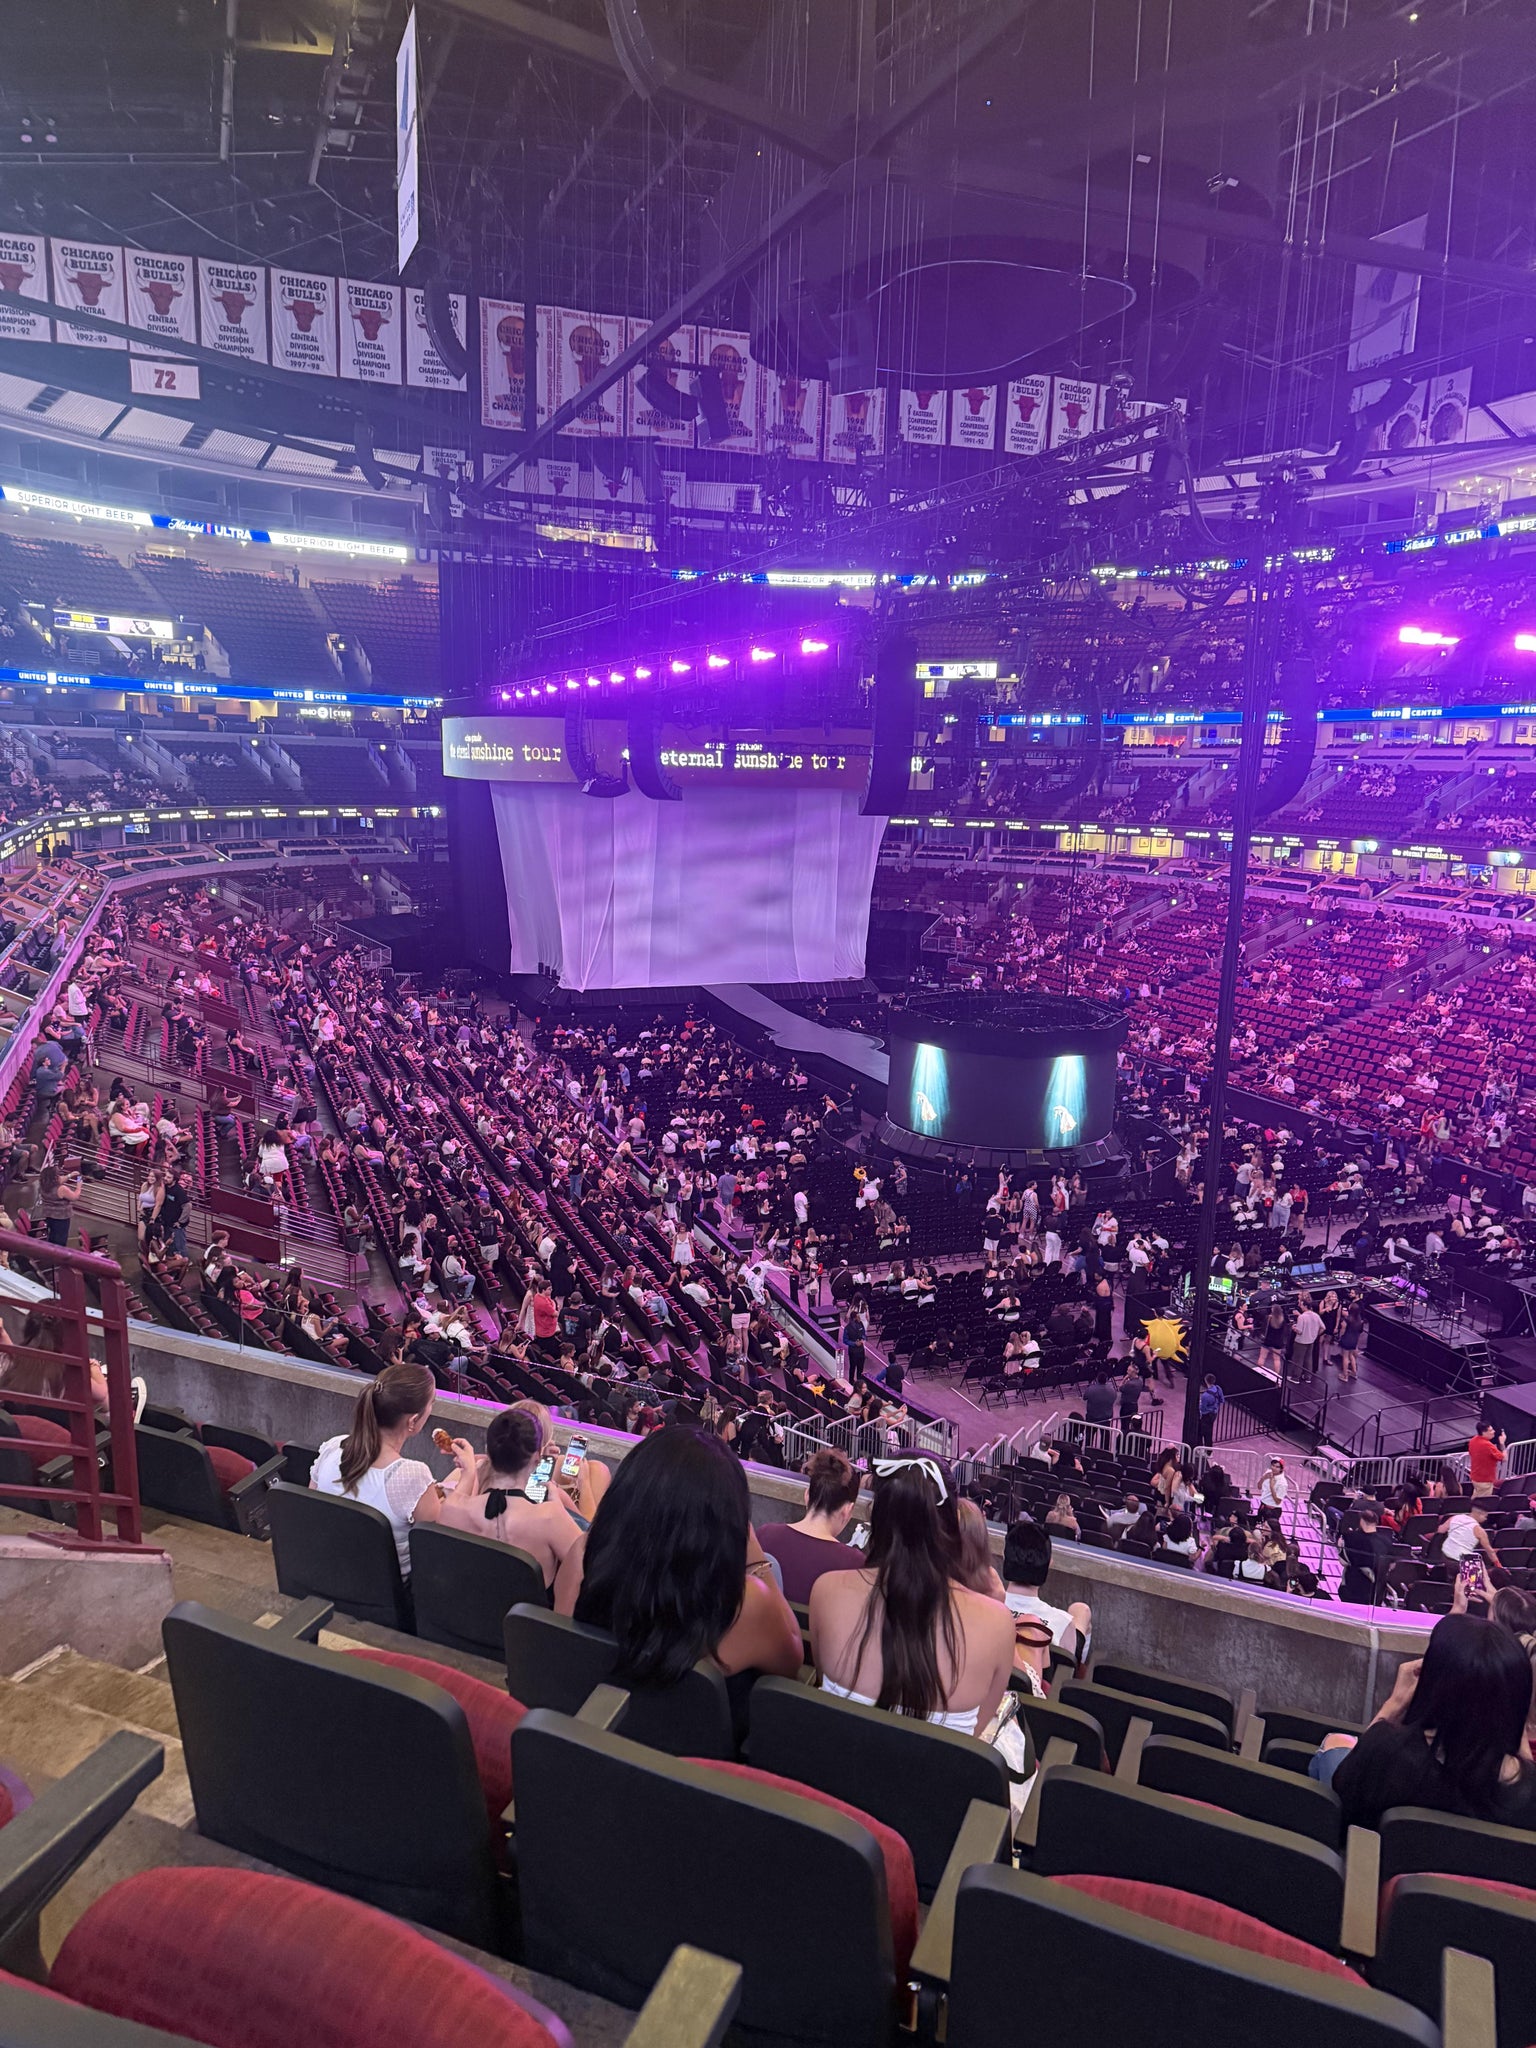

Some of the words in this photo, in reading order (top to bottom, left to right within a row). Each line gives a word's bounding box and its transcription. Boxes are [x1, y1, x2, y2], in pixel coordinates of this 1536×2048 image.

[0, 240, 35, 252] ICAGO
[0, 252, 29, 262] ULLS
[61, 246, 114, 261] CHICAGO
[70, 259, 108, 272] BULLS
[134, 256, 185, 271] CHICAGO
[143, 269, 179, 282] BULLS
[208, 266, 257, 280] CHICAGO
[216, 278, 251, 292] BULLS
[280, 275, 327, 291] CHICAGO
[287, 287, 321, 301] BULLS
[347, 285, 393, 301] CHICAGO
[355, 297, 387, 310] BULLS
[0, 317, 37, 326] AMPIONS
[148, 314, 177, 324] CENTRAL
[147, 323, 179, 334] DIVISION
[219, 324, 248, 335] CENTRAL
[76, 332, 108, 343] 1992-93
[218, 334, 249, 344] DIVISION
[290, 333, 318, 343] CENTRAL
[213, 342, 255, 354] CHAMPIONS
[289, 342, 320, 352] DIVISION
[358, 341, 385, 351] CENTRAL
[285, 350, 325, 362] CHAMPIONS
[357, 350, 386, 361] DIVISION
[352, 359, 391, 370] CHAMPIONS
[423, 358, 444, 367] DIVISI
[359, 368, 385, 378] 2010-11
[418, 366, 452, 377] CHAMPIO
[154, 368, 176, 390] 72
[425, 376, 450, 385] 2011-12
[1059, 383, 1092, 395] CHICAGO
[1446, 379, 1455, 391] 3
[1016, 386, 1040, 396] BULLS
[1064, 392, 1087, 403] BULLS
[912, 410, 934, 418] EASTERN
[908, 417, 938, 426] CONFERENCE
[960, 422, 989, 430] CONFERENCE
[1015, 421, 1035, 430] EASTERN
[908, 424, 938, 433] CHAMPIONS
[960, 430, 989, 438] CHAMPIONS
[18, 491, 70, 509] SUPERIOR
[72, 502, 101, 515] LIGHT
[105, 509, 134, 521] BEER
[214, 525, 252, 540] ULTRA
[283, 535, 334, 548] SUPERIOR
[338, 542, 366, 551] LIGHT
[370, 545, 395, 555] BEER
[19, 672, 46, 681] UNITED
[57, 676, 90, 684] CENTER
[144, 682, 173, 691] UNITED
[184, 685, 218, 693] CENTER
[273, 690, 304, 699] UNITED
[314, 693, 347, 701] CENTER
[1372, 710, 1401, 718] UNITED
[1411, 709, 1442, 717] CENTER
[1501, 706, 1536, 714] UNITED
[522, 744, 561, 761] tour
[660, 751, 723, 767] eternal
[734, 752, 803, 769] sunshe
[811, 753, 846, 770] tor
